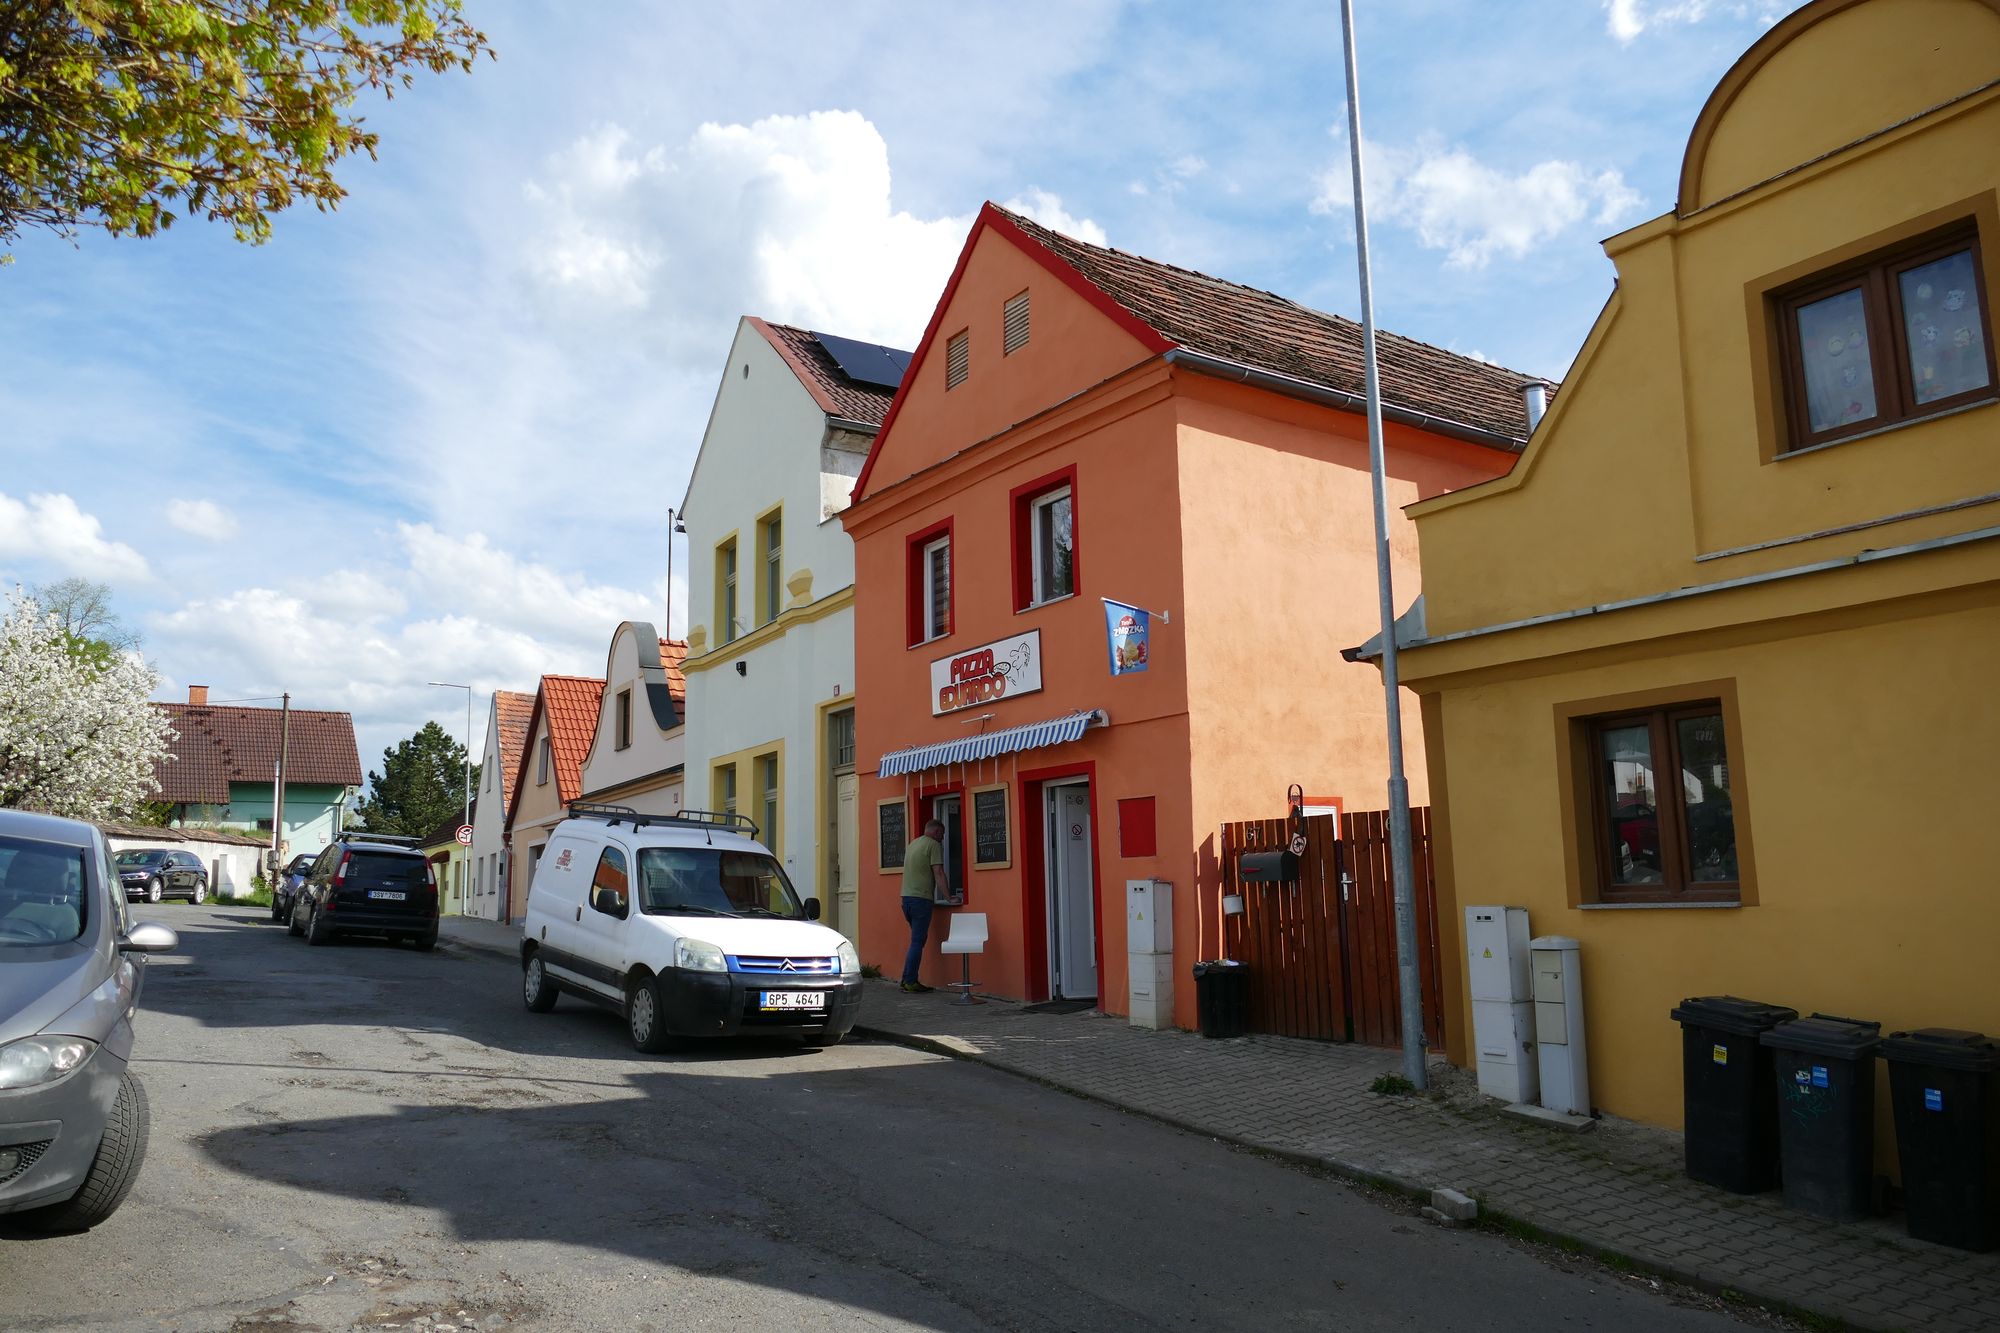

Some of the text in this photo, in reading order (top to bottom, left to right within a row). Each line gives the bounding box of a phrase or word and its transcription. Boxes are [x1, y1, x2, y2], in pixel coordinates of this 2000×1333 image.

[950, 648, 994, 685] PIZZA
[939, 671, 1006, 711] EDUARDO
[1246, 827, 1260, 841] 67
[769, 994, 788, 1005] 6P5
[796, 994, 819, 1005] 4641
